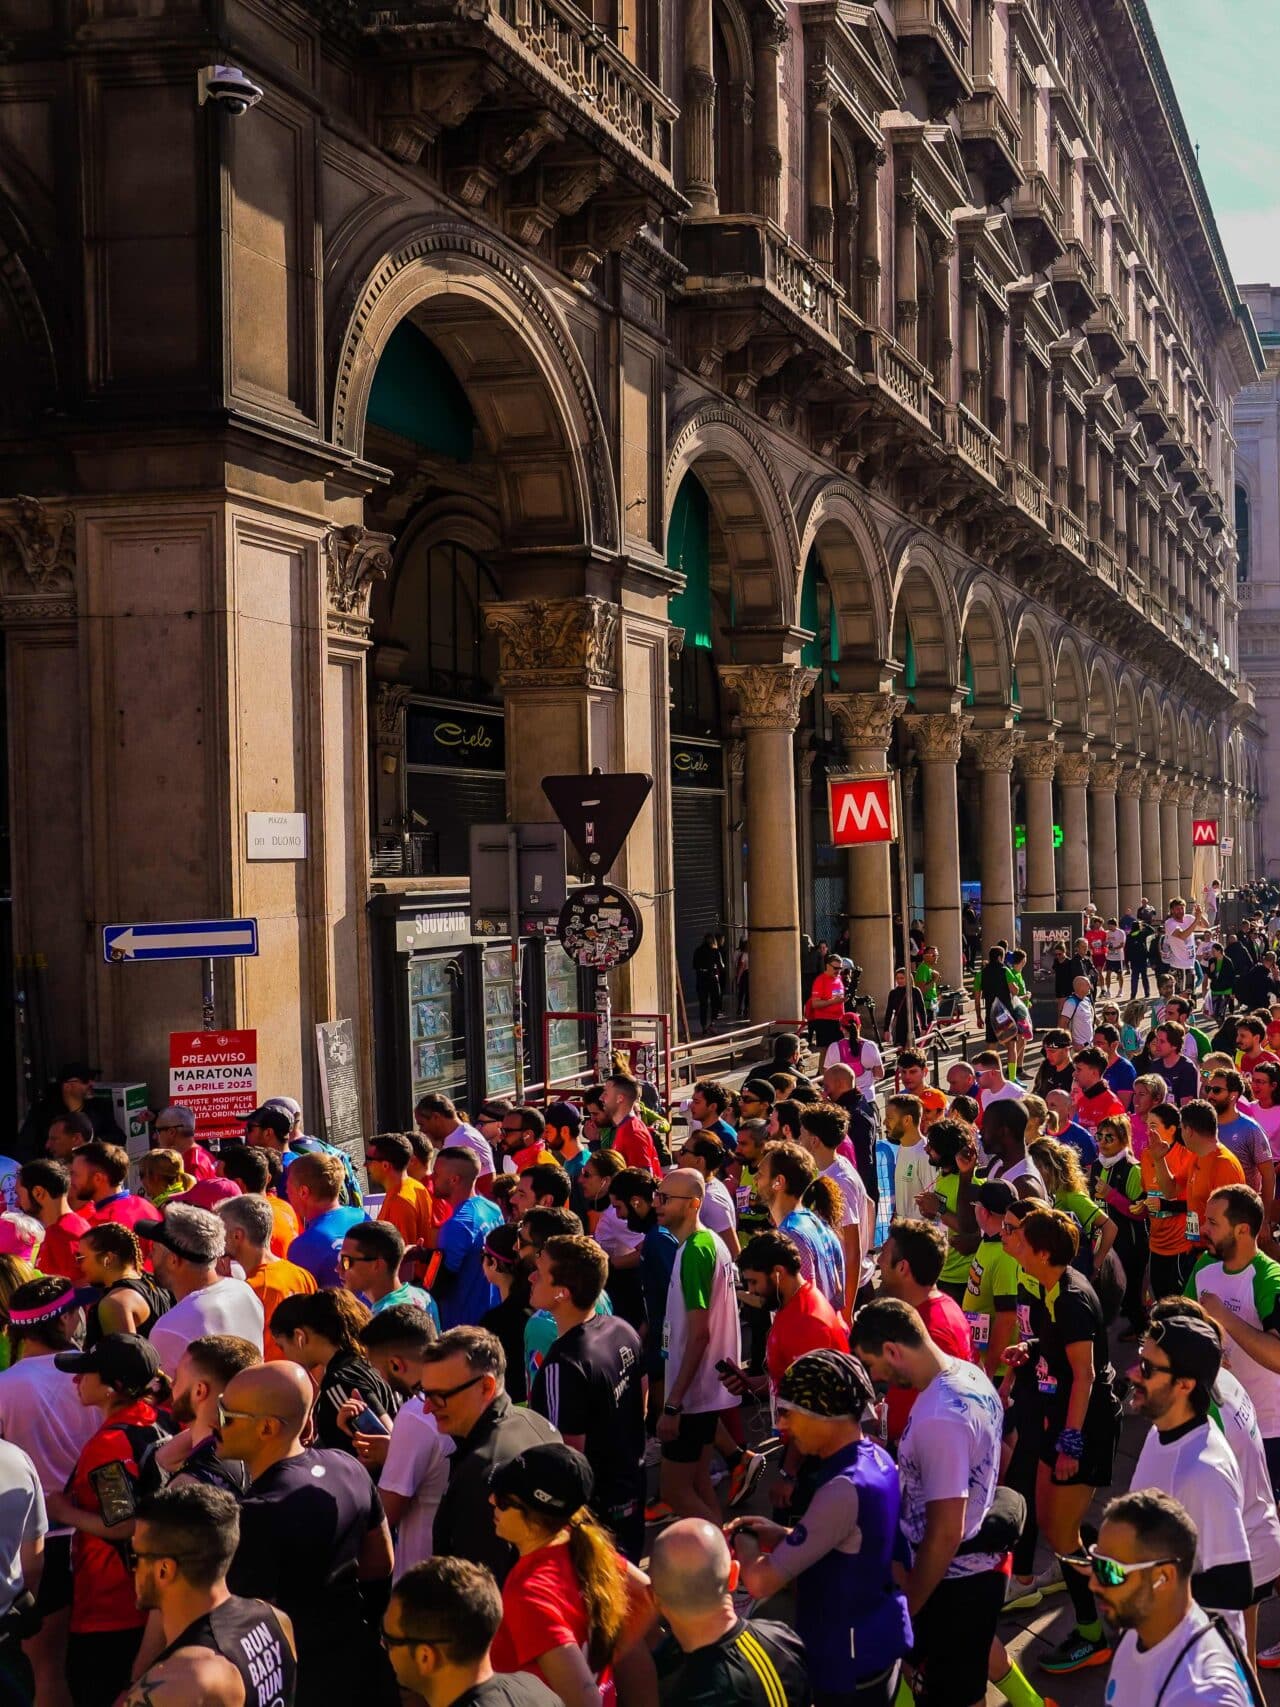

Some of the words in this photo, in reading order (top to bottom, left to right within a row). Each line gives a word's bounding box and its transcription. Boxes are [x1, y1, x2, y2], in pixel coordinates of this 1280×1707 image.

[433, 722, 492, 748] Cielo
[673, 752, 709, 771] Cielo
[837, 791, 888, 833] M
[272, 835, 301, 846] DUOMO
[1195, 825, 1215, 841] M
[415, 911, 466, 934] SOUVENIR
[1033, 929, 1070, 938] MILANO
[182, 1053, 245, 1064] PREAVVISO
[174, 1067, 253, 1080] MARATONA
[187, 1082, 224, 1091] APRILE
[227, 1080, 252, 1088] 2025
[174, 1097, 209, 1106] PREVISTE
[212, 1095, 253, 1104] MODIFICHE
[240, 1621, 273, 1661] RUN
[248, 1640, 282, 1688] BABY
[257, 1667, 283, 1707] RUN
